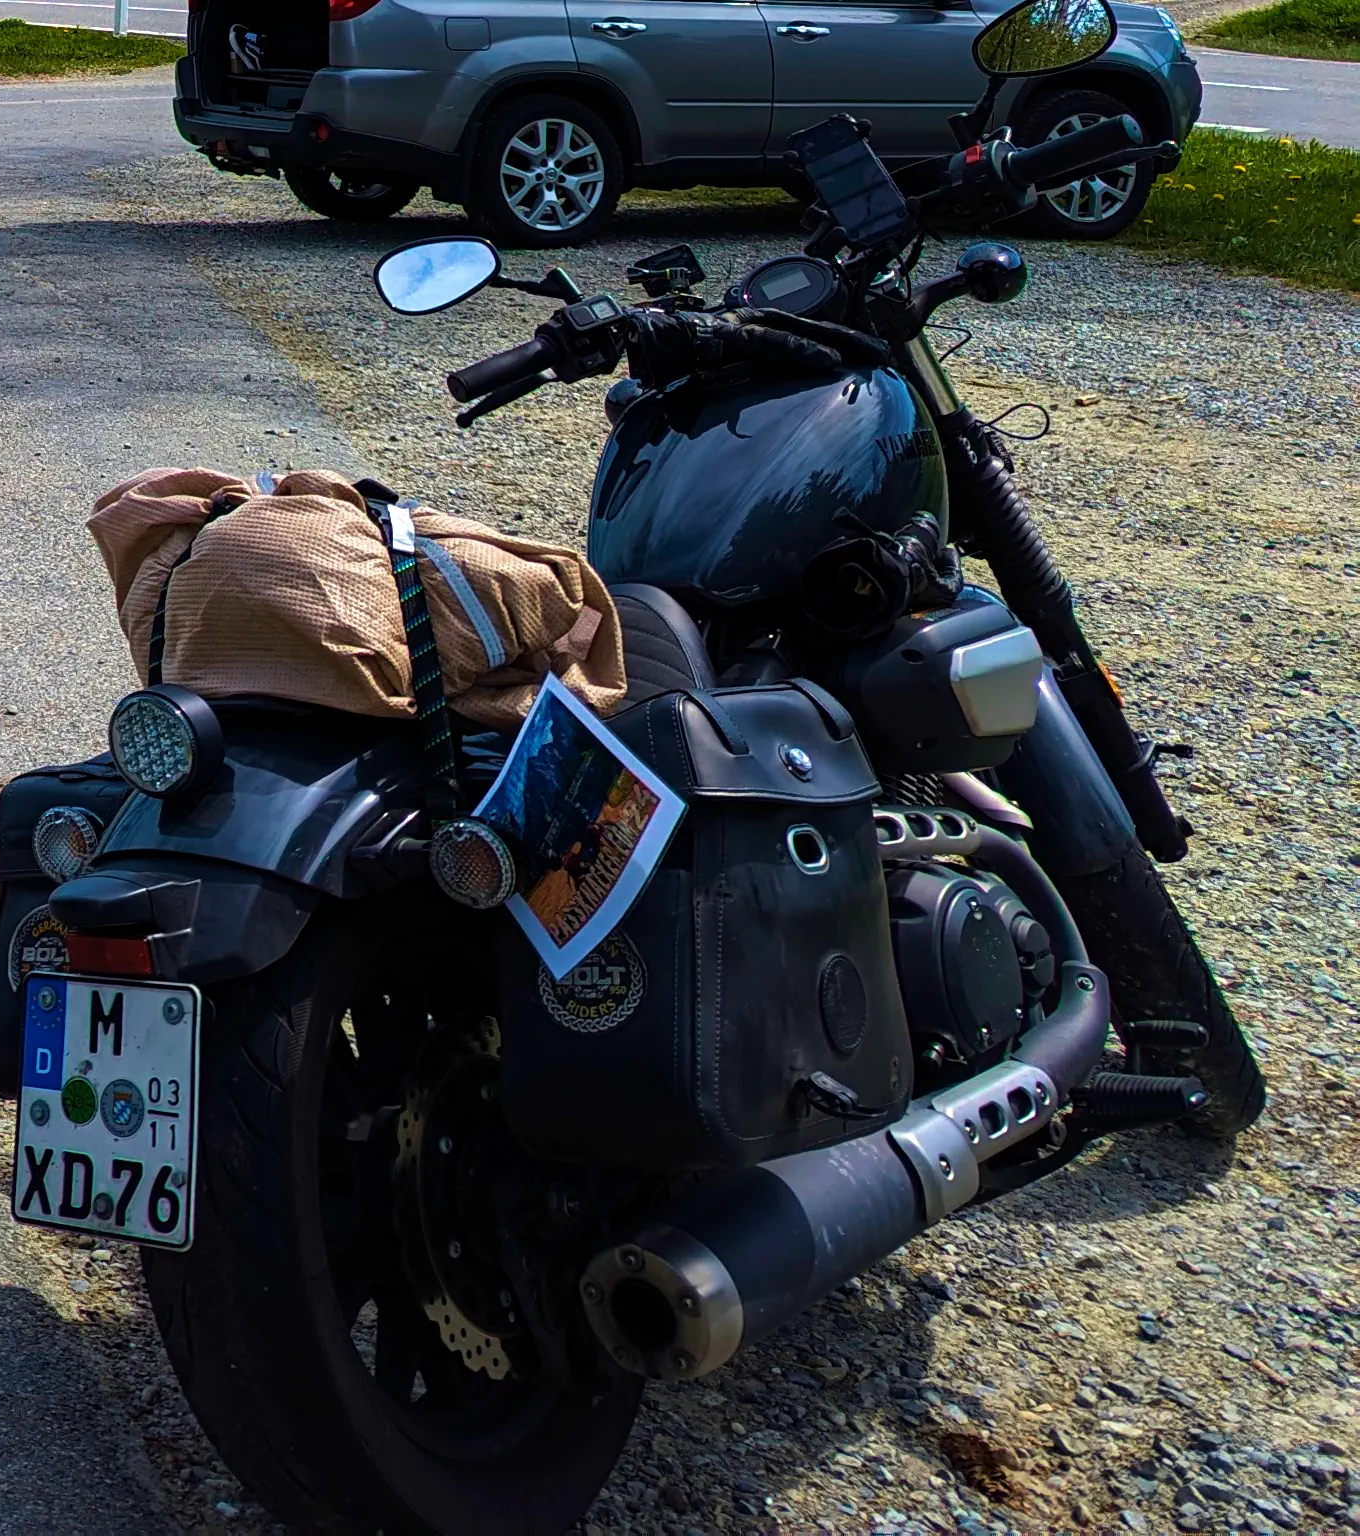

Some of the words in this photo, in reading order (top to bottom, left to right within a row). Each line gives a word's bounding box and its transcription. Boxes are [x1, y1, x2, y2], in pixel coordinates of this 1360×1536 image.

[609, 985, 627, 995] 950
[89, 990, 124, 1056] M
[565, 998, 617, 1019] RIDERS
[35, 1048, 52, 1074] D
[148, 1076, 180, 1107] 03
[148, 1120, 177, 1151] 11
[20, 1145, 94, 1220] XD
[111, 1157, 181, 1234] 76
